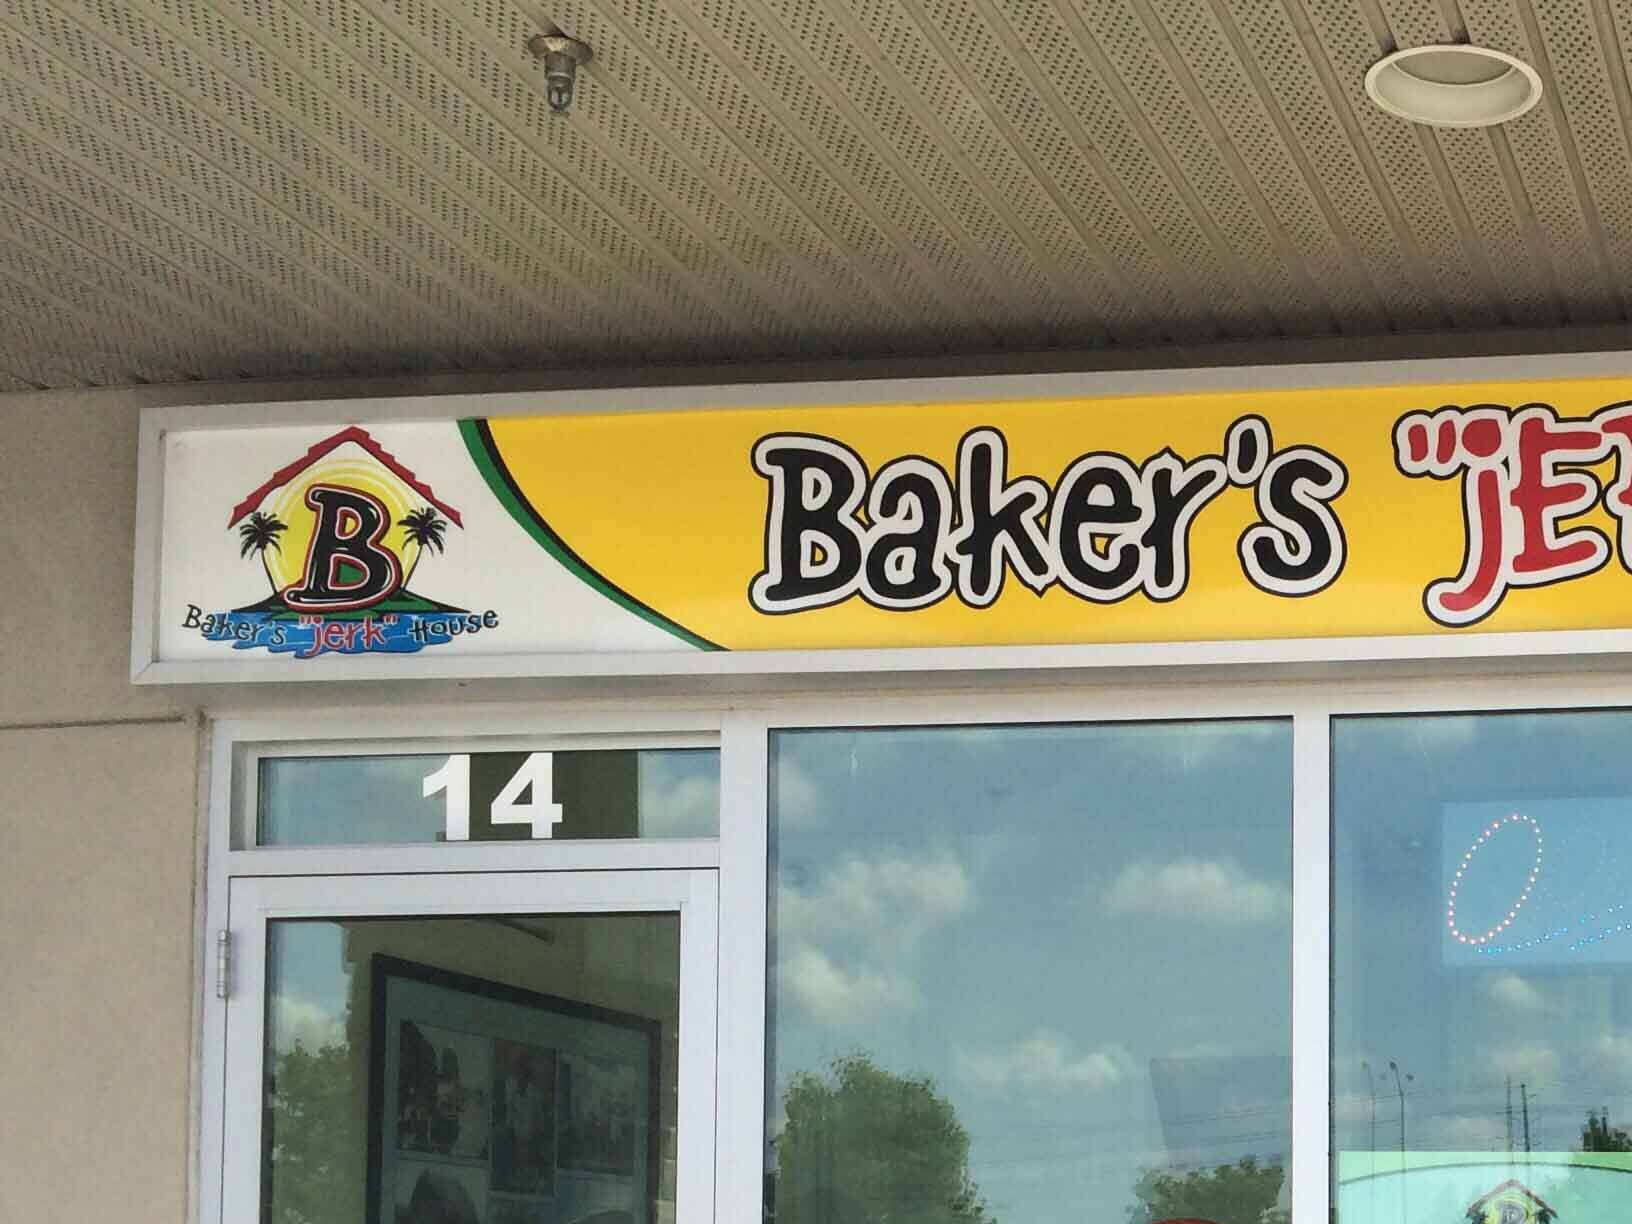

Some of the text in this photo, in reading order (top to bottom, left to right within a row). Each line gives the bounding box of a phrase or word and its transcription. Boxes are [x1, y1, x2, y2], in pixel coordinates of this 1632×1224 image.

[283, 482, 402, 612] B
[748, 414, 1349, 615] Baker's
[181, 603, 288, 646] Baker's
[408, 608, 500, 643] House
[422, 752, 563, 841] 14
